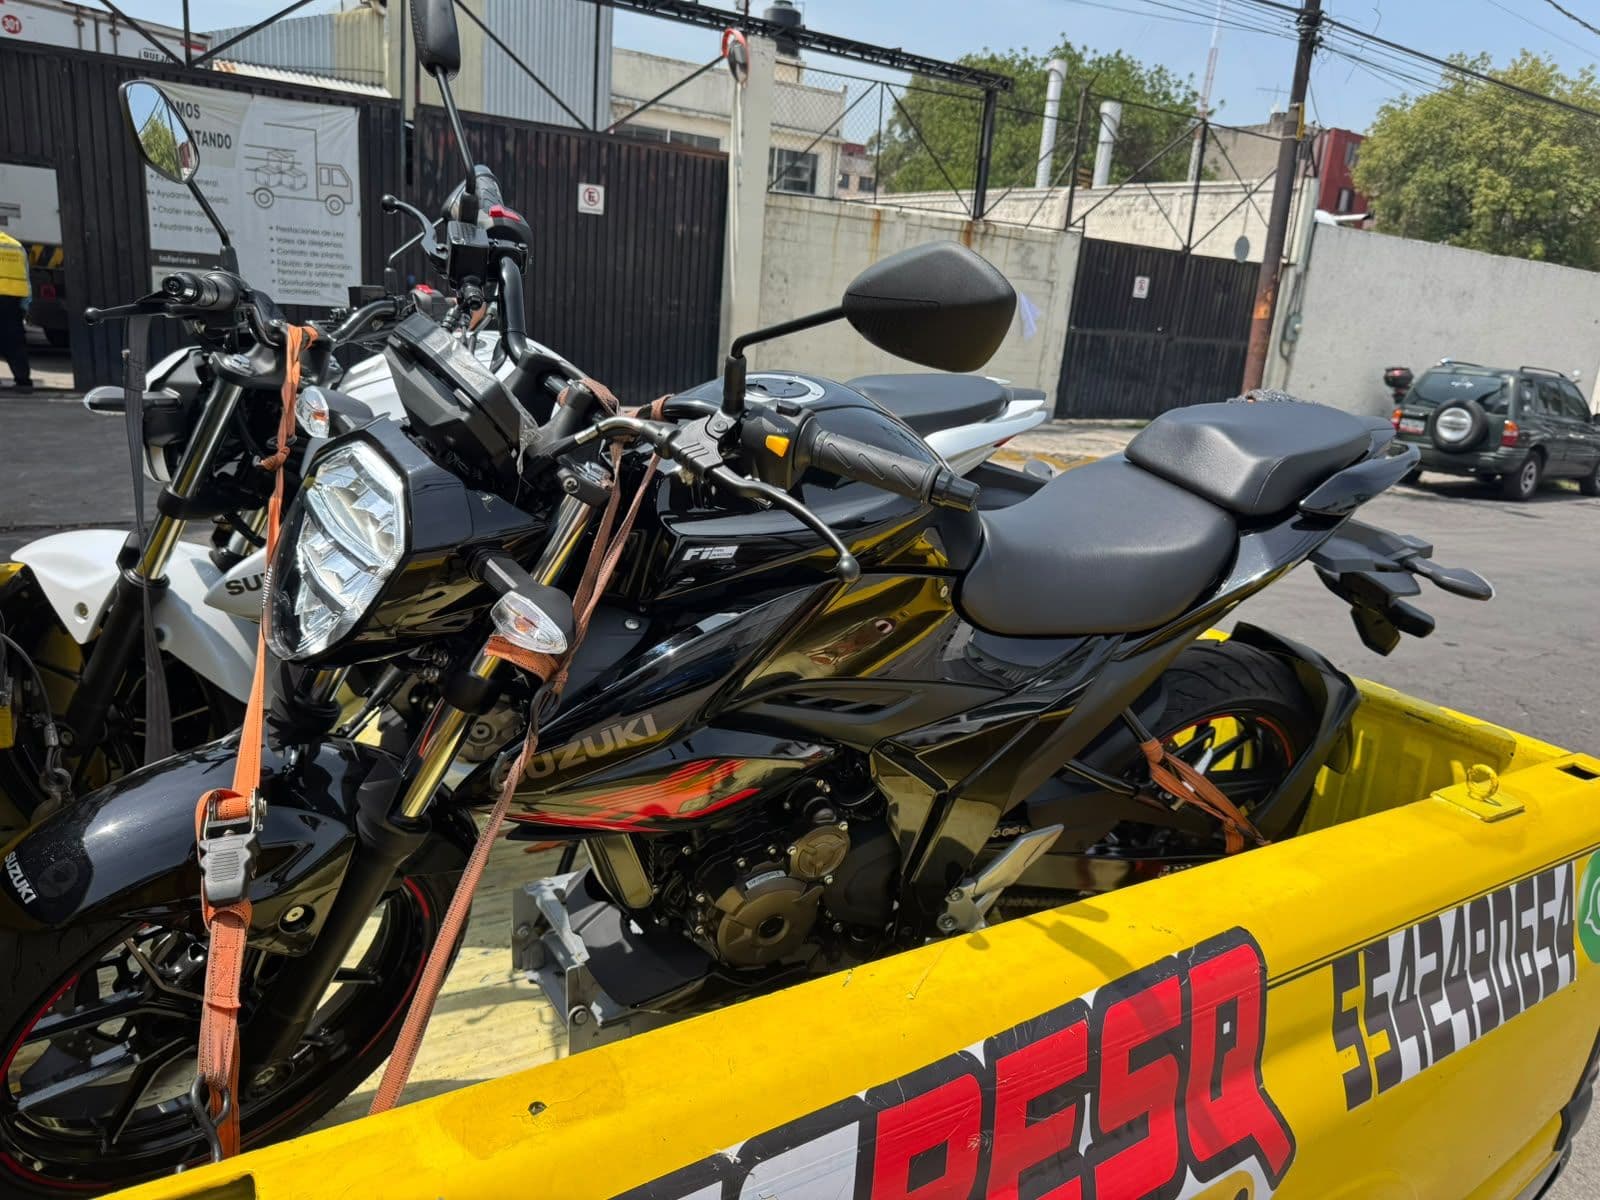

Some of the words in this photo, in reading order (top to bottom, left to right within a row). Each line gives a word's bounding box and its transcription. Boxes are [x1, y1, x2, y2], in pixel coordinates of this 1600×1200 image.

[174, 101, 201, 119] MOS
[4, 850, 38, 905] SUZUKI
[1332, 860, 1576, 1112] 5542490654
